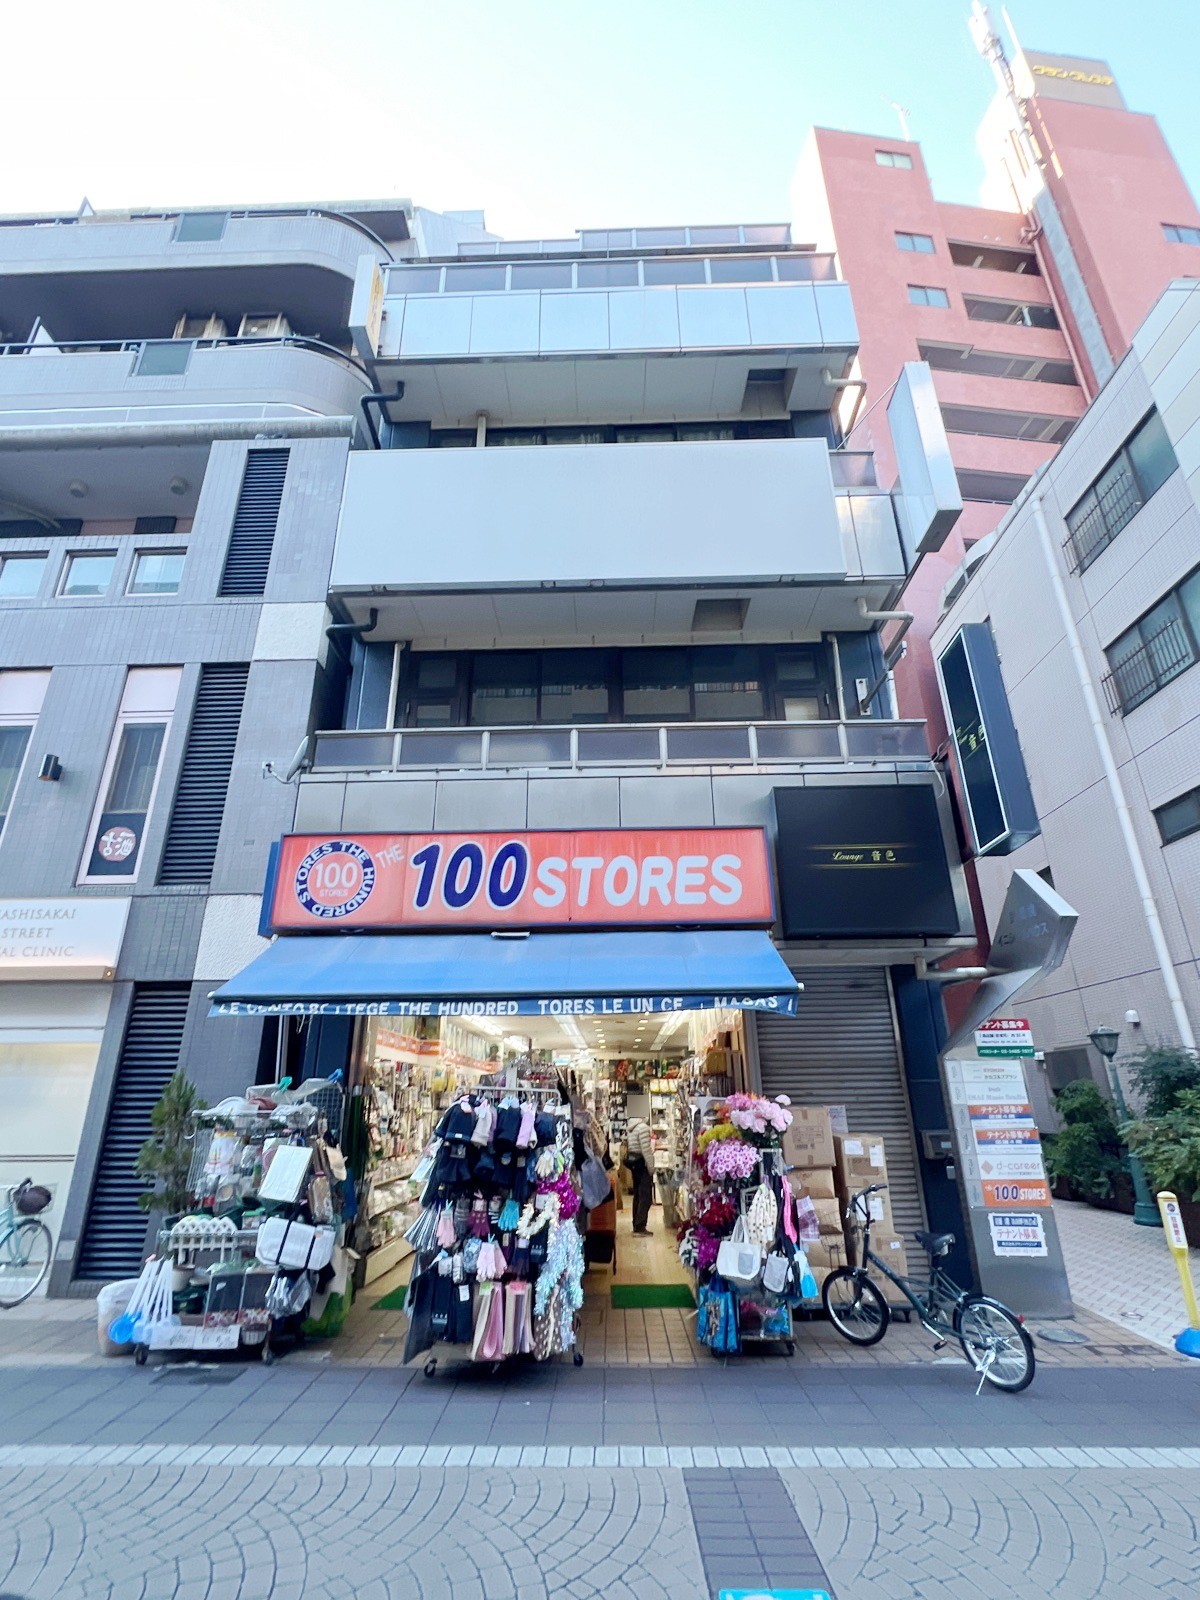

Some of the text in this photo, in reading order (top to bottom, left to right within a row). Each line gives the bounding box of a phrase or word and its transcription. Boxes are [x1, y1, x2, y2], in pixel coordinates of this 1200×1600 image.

[296, 842, 375, 917] THE HUNDRED STORES
[315, 862, 358, 888] 100
[375, 840, 743, 911] THE 100 STORES
[0, 909, 76, 919] ASHISAKAI
[1, 928, 53, 938] STREET
[0, 946, 74, 957] AL CLINIC
[399, 1002, 431, 1015] THE
[438, 1000, 519, 1015] HUNDRED
[602, 998, 624, 1013] LE
[630, 997, 654, 1012] UN
[994, 1184, 1020, 1201] 100
[1019, 1187, 1047, 1201] STORES
